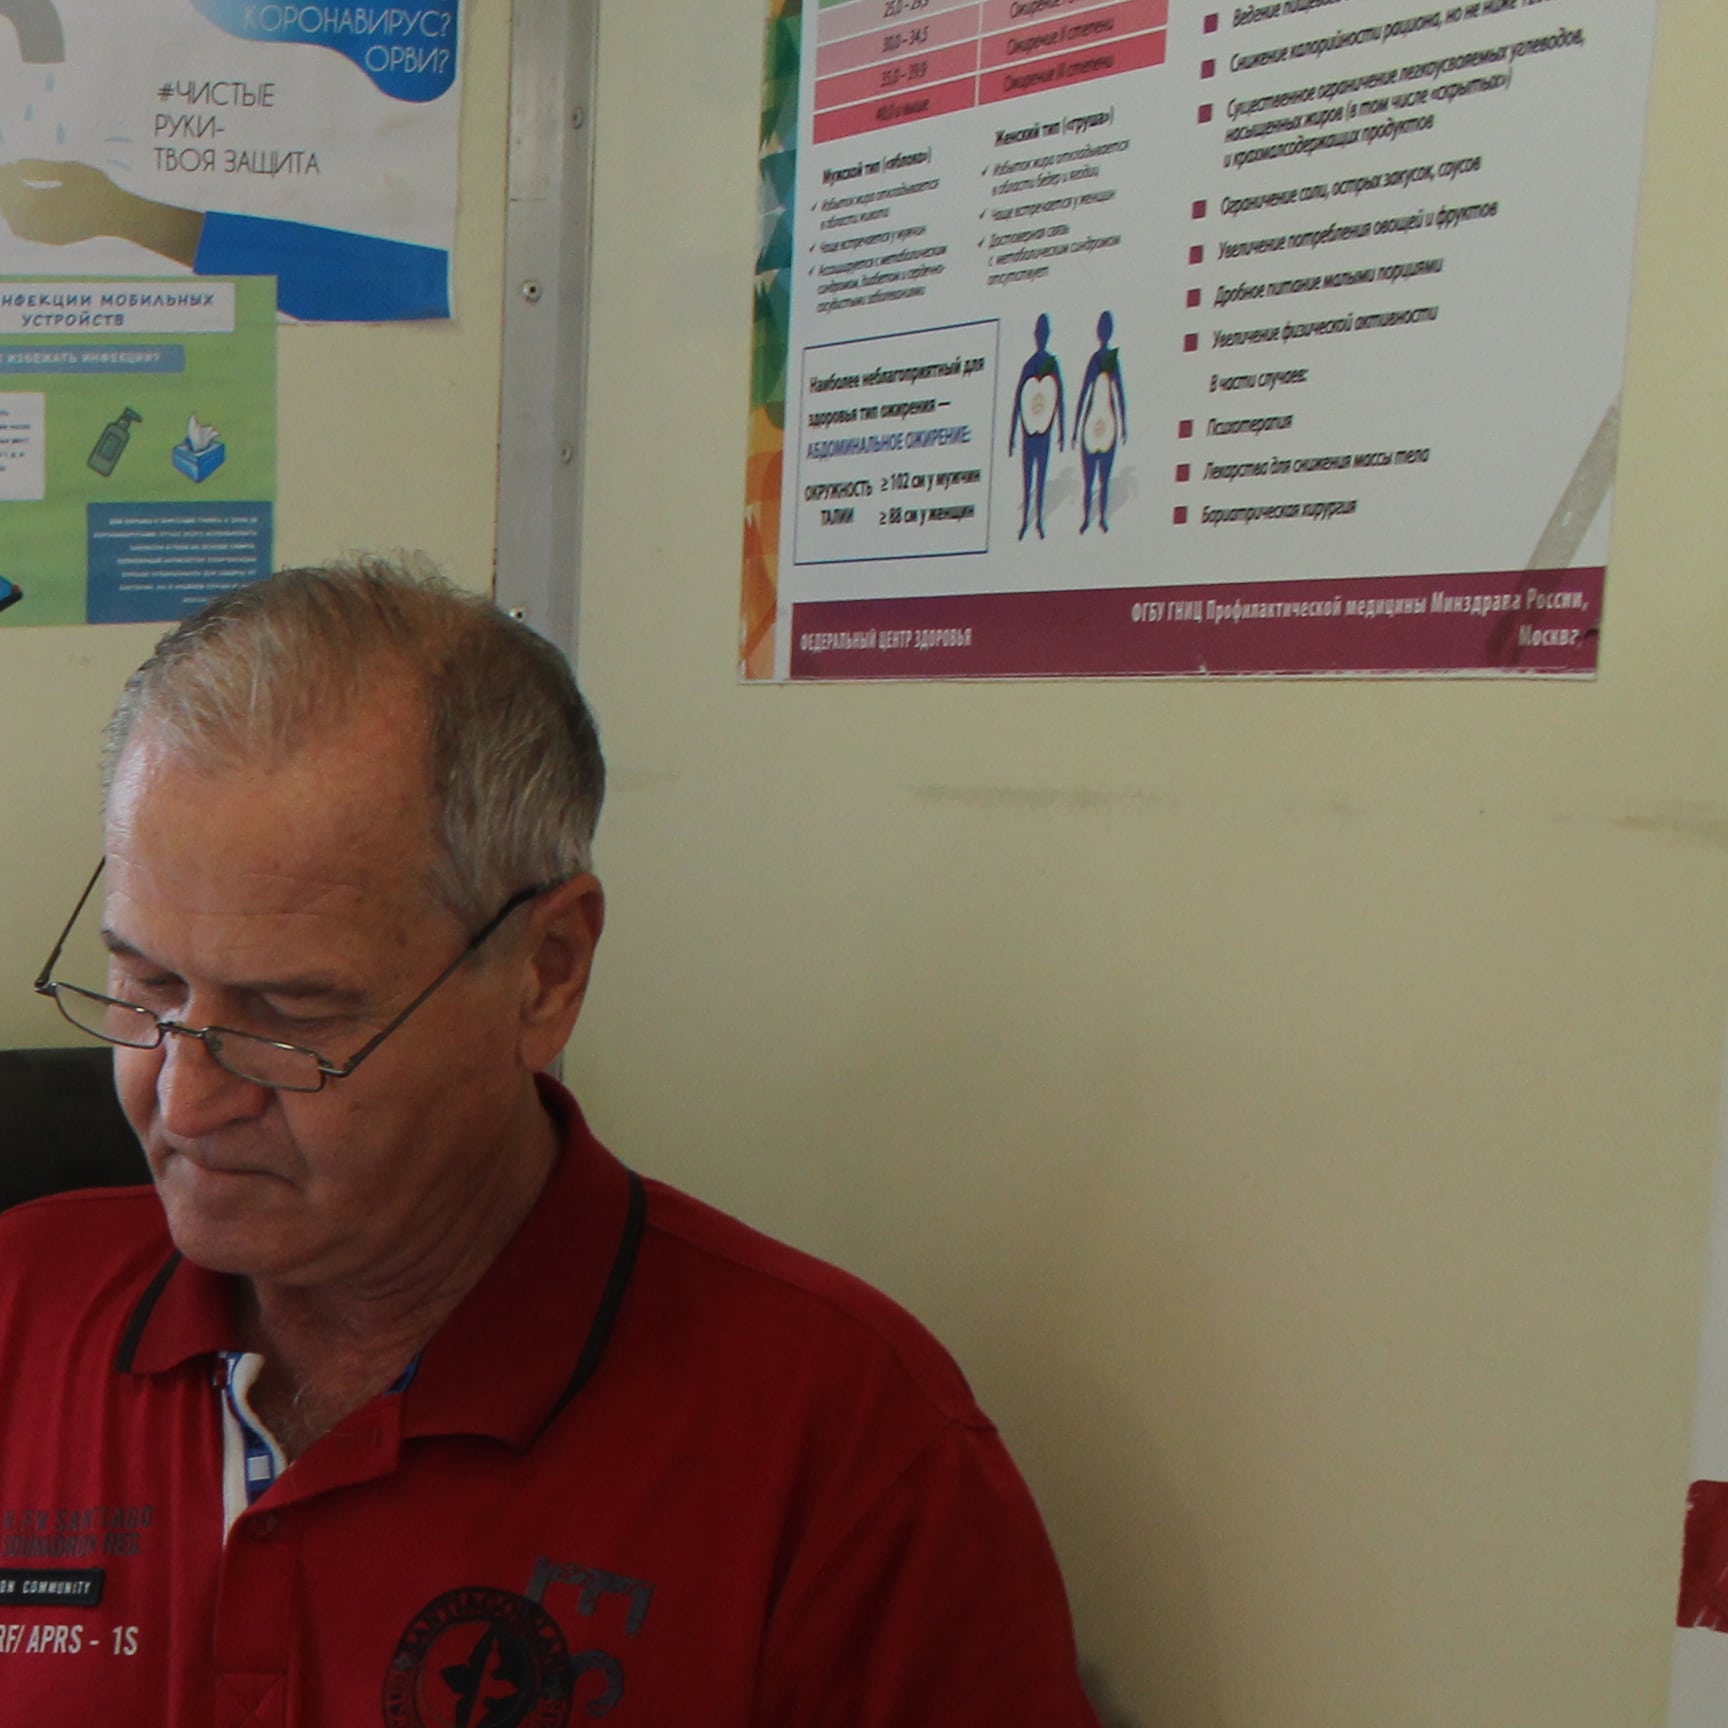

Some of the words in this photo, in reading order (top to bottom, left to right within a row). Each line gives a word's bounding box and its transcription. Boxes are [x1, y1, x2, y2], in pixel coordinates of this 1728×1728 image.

[243, 5, 451, 38] КОРОНАВИРУС?
[1233, 4, 1281, 27] Ведение
[1231, 42, 1287, 73] Снижение
[1289, 27, 1382, 60] калорийности
[1383, 13, 1442, 41] рациона,
[1445, 8, 1462, 24] но
[1465, 5, 1480, 19] не
[365, 45, 448, 74] ОРВИ?
[1226, 84, 1315, 119] Существенное
[1317, 68, 1398, 102] ограничение
[1399, 47, 1507, 83] легкоусвояемых
[1509, 27, 1585, 64] углеводов,
[157, 81, 275, 107] #ЧИСТЫЕ
[155, 113, 224, 138] РУКИ-
[1224, 113, 1304, 144] насыщенных
[1305, 104, 1342, 132] жиров
[1362, 113, 1434, 147] продуктов
[155, 148, 215, 172] ТВОЯ
[224, 150, 320, 178] ЗАЩИТА
[1221, 191, 1297, 217] Ограничение
[1332, 176, 1381, 198] острых
[1438, 155, 1481, 182] соусов
[1218, 235, 1286, 260] Увеличение
[1287, 222, 1371, 250] потребления
[1372, 209, 1424, 235] овощей
[1426, 213, 1434, 227] и
[1436, 201, 1498, 229] фруктов
[1214, 283, 1264, 308] Дробное
[1266, 275, 1321, 297] питание
[1323, 268, 1376, 288] малыми
[1377, 257, 1443, 286] порциями
[101, 294, 214, 307] МОБИЛЬНЫХ
[22, 311, 124, 327] УСТРОЙСТВ
[1213, 324, 1280, 349] Увеличение
[1281, 312, 1354, 344] физической
[1354, 305, 1439, 330] активности
[8, 353, 77, 364] ИЗБЕЖАТЬ
[809, 372, 860, 393] Наиболее
[862, 356, 961, 387] неблагоприятный
[962, 357, 985, 378] для
[1209, 374, 1218, 392] В
[1219, 372, 1256, 390] части
[808, 408, 858, 429] здоровья
[860, 406, 878, 419] тип
[880, 399, 936, 421] ожирения
[1207, 414, 1293, 437] Психотерапия
[806, 432, 904, 461] АБДОМИНАЛЬНОЕ
[1203, 460, 1267, 482] Лекарства
[1269, 456, 1291, 475] для
[1293, 455, 1351, 474] снижения
[1352, 450, 1392, 469] массы
[1394, 447, 1430, 465] тела
[805, 480, 873, 501] ОКРУЖНОСТЬ
[891, 472, 908, 490] 102
[936, 469, 981, 490] мужчин
[821, 508, 854, 526] ТАЛИИ
[929, 504, 975, 522] женщин
[1201, 501, 1301, 527] Бариатрическая
[1302, 500, 1357, 521] хирургия
[1131, 600, 1166, 624] ФГБУ
[1168, 599, 1203, 624] ГНИЦ
[1206, 594, 1341, 625] Профилактической
[1346, 597, 1428, 620] медицины
[1431, 590, 1521, 618] Минздрава
[1526, 587, 1589, 614] России,
[800, 628, 877, 654] ФЕДЕРАЛЬНЫЙ
[878, 630, 912, 653] ЦЕНТР
[914, 627, 972, 652] ЗДОРОВЬЯ
[22, 1580, 91, 1594] COMMUNITY
[26, 1625, 84, 1654] APRS
